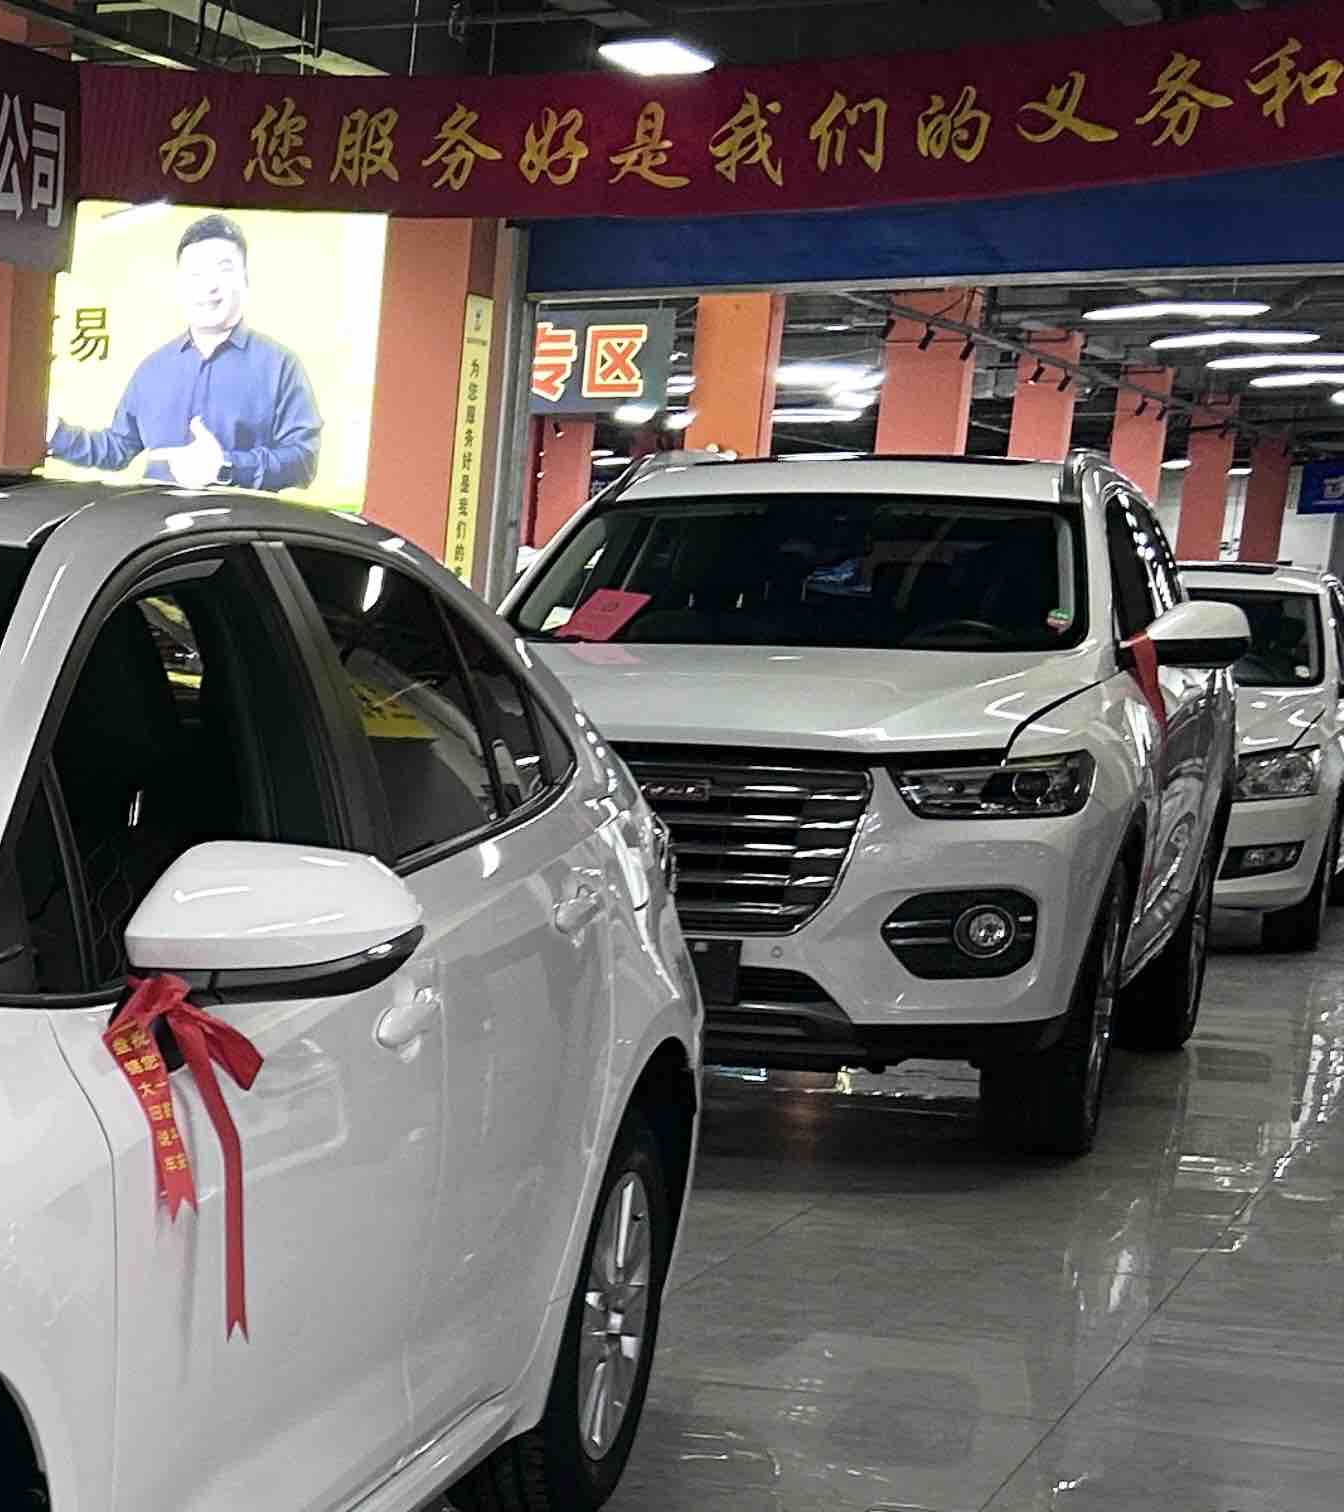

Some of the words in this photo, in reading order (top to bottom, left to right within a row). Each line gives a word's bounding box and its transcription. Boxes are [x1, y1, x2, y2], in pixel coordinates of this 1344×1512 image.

[158, 38, 1344, 191] 为您服务好是我们的义务和
[52, 308, 110, 362] 易
[531, 322, 648, 402] 专区
